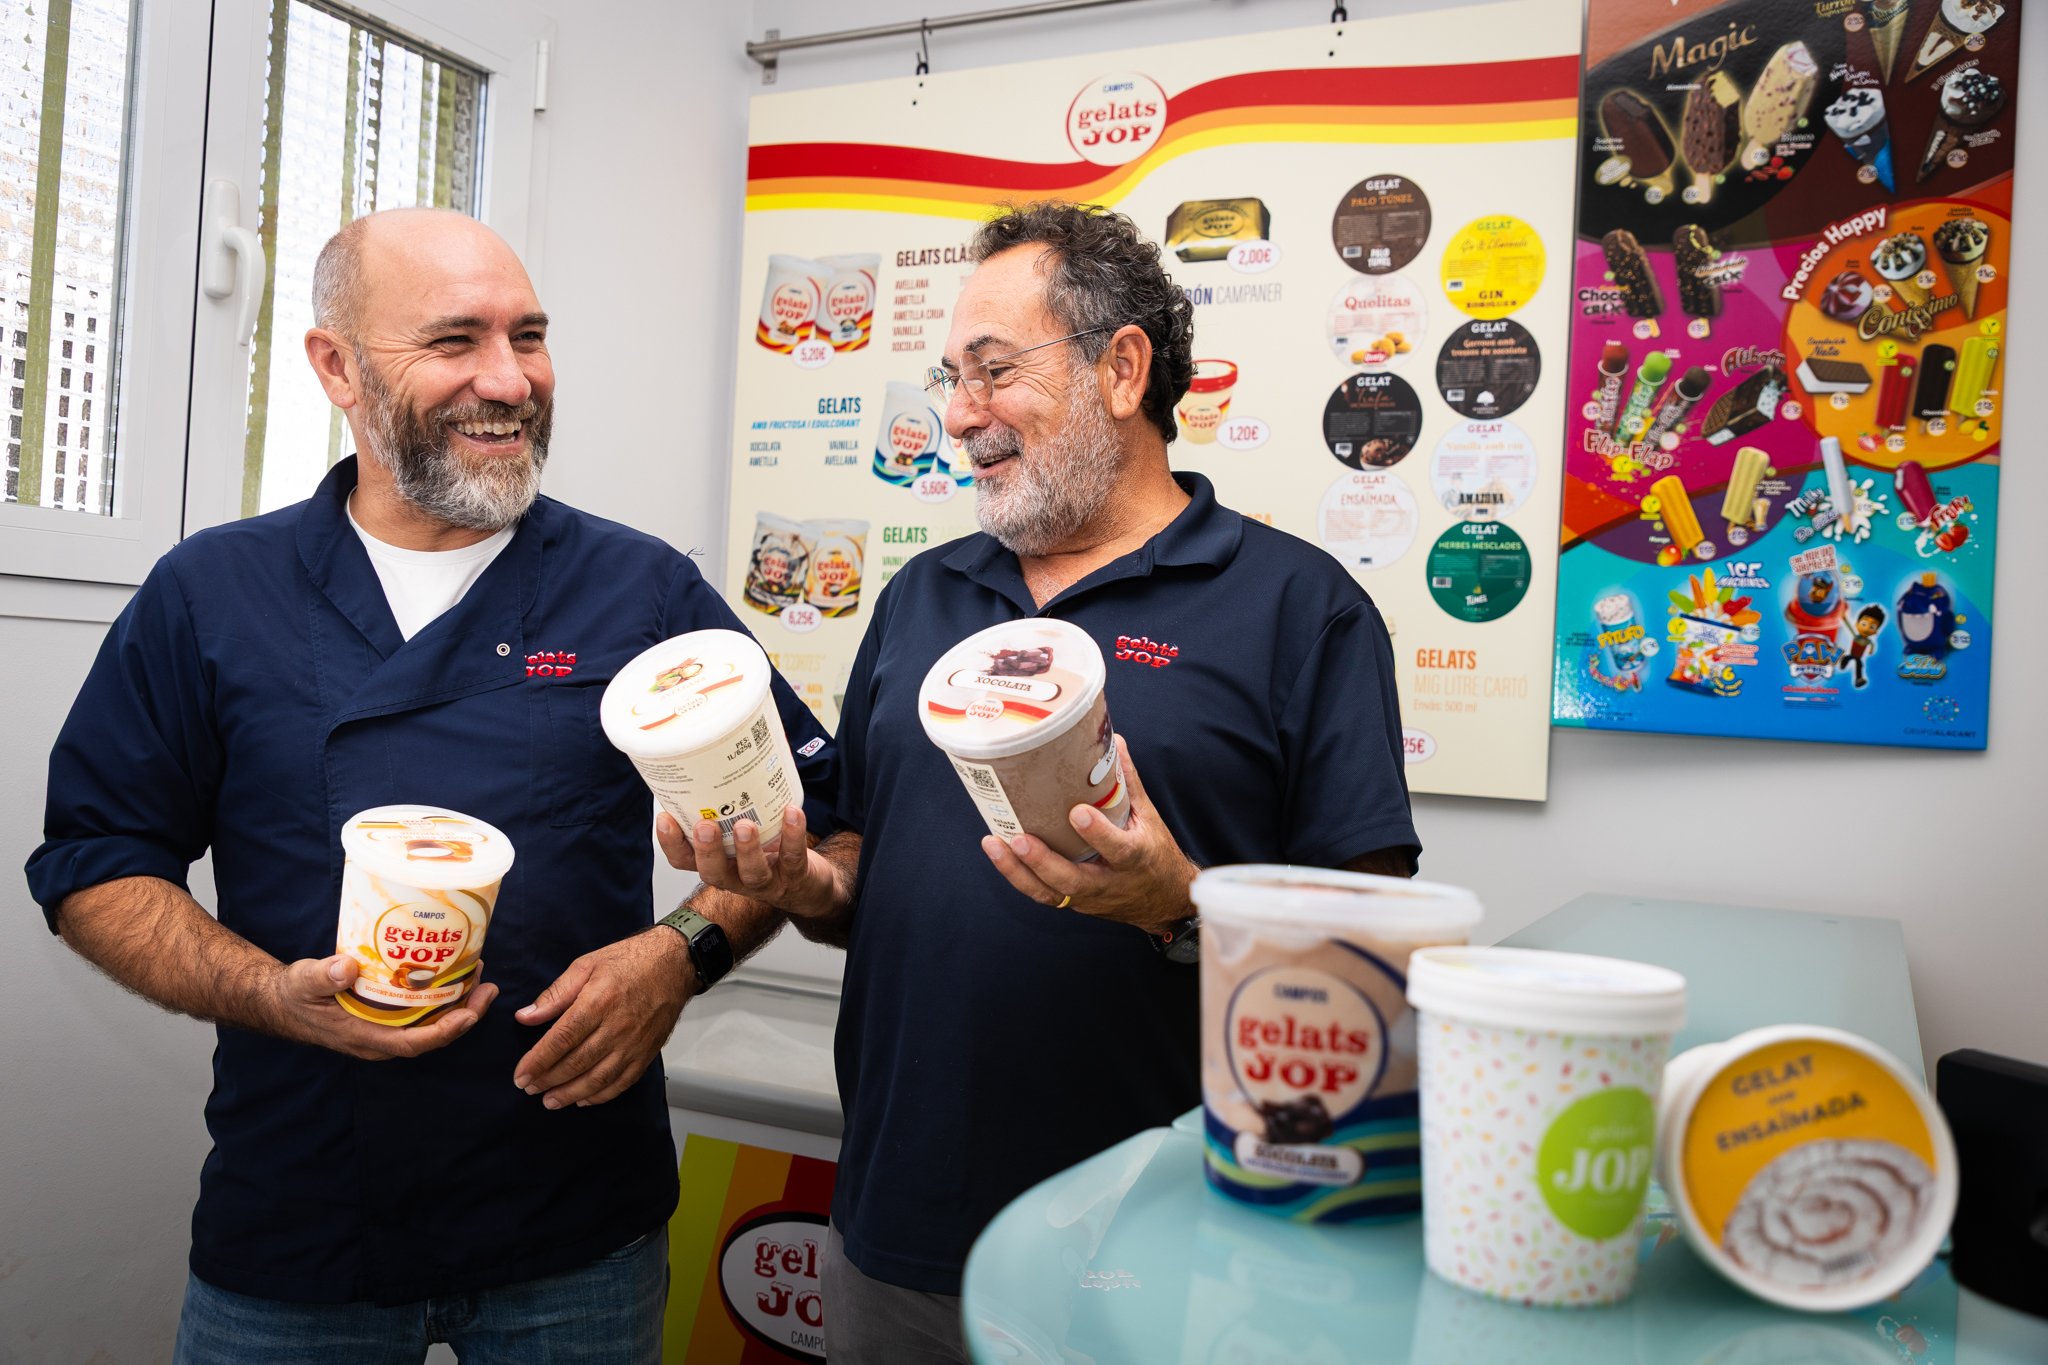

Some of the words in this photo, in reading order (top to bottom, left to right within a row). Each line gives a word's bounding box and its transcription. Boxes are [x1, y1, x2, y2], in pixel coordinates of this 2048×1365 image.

[1648, 22, 1759, 80] Magic
[1103, 81, 1134, 94] CAMPOS
[1078, 100, 1158, 129] gelats
[1082, 124, 1152, 146] JOP
[1365, 178, 1402, 191] GELAT
[1351, 197, 1378, 207] PALO
[897, 249, 940, 267] GELATS
[1238, 248, 1272, 266] 2,00€
[1782, 240, 1830, 300] Precios
[1823, 206, 1887, 245] Happy
[895, 279, 930, 290] AVELLANA
[894, 294, 925, 305] AMETLLA
[1216, 283, 1283, 304] CAMPANER
[1479, 290, 1503, 299] GIN
[1579, 289, 1627, 301] Choco
[776, 307, 804, 320] JOP
[832, 304, 863, 317] JOP
[893, 310, 925, 321] AMETLLA
[893, 326, 923, 336] VAINILLA
[1471, 321, 1508, 333] GELAT
[892, 341, 926, 352] XOCOLATA
[800, 347, 827, 362] 5,20€
[1356, 376, 1392, 387] GELAT
[818, 397, 862, 414] GELATS
[751, 420, 769, 430] AMB
[769, 419, 806, 430] FRUCTOSA
[811, 418, 861, 429] EDULCORANT
[1467, 424, 1503, 433] GELAT
[893, 425, 928, 442] gelats
[1229, 426, 1259, 443] 1,20€
[750, 441, 781, 452] XOCOLATA
[829, 440, 859, 451] VAINILLA
[893, 437, 923, 451] JOP
[1583, 427, 1674, 471] Flip-Flap
[749, 456, 778, 467] AMETLLA
[824, 455, 858, 466] AVELLANA
[1352, 475, 1386, 484] GELAT
[920, 480, 949, 496] 5,60€
[1340, 491, 1398, 506] ENSAÏMADA
[883, 526, 928, 544] GELATS
[1462, 524, 1499, 535] GELAT
[1438, 541, 1471, 550] HERBES
[1471, 541, 1522, 550] MESCLADES
[817, 560, 851, 570] gelats
[1726, 562, 1763, 578] ICE
[818, 570, 849, 581] JOP
[1597, 625, 1645, 648] PITUFO
[1115, 635, 1179, 658] gelats
[1781, 640, 1845, 666] PAW
[524, 650, 577, 665] elats
[1114, 649, 1171, 668] JOP
[1416, 648, 1477, 671] GELATS
[1722, 666, 1736, 681] 6
[660, 676, 707, 701] AVELLANA
[974, 676, 1033, 692] XOCOLATA
[1414, 674, 1441, 695] MIG
[1444, 674, 1479, 697] LITRE
[1483, 673, 1528, 699] CARTÓ
[970, 702, 1000, 714] gelats
[1445, 701, 1463, 713] 500
[1465, 701, 1478, 713] ml
[968, 711, 995, 720] JOP
[735, 736, 750, 750] PES:
[727, 742, 752, 761] 1L/625g
[413, 910, 445, 920] CAMPOS
[384, 924, 463, 944] gelats
[387, 944, 455, 963] JOP
[364, 985, 389, 997] IOGURT
[1272, 981, 1330, 1005] CAMPOS
[1238, 1014, 1370, 1057] gelats
[1243, 1052, 1360, 1094] JOP
[1731, 1053, 1815, 1099] GELAT
[1714, 1089, 1868, 1154] ENSAÏMADA
[755, 1236, 823, 1280] gel
[756, 1281, 824, 1328] JO
[791, 1330, 826, 1351] CAMPO
